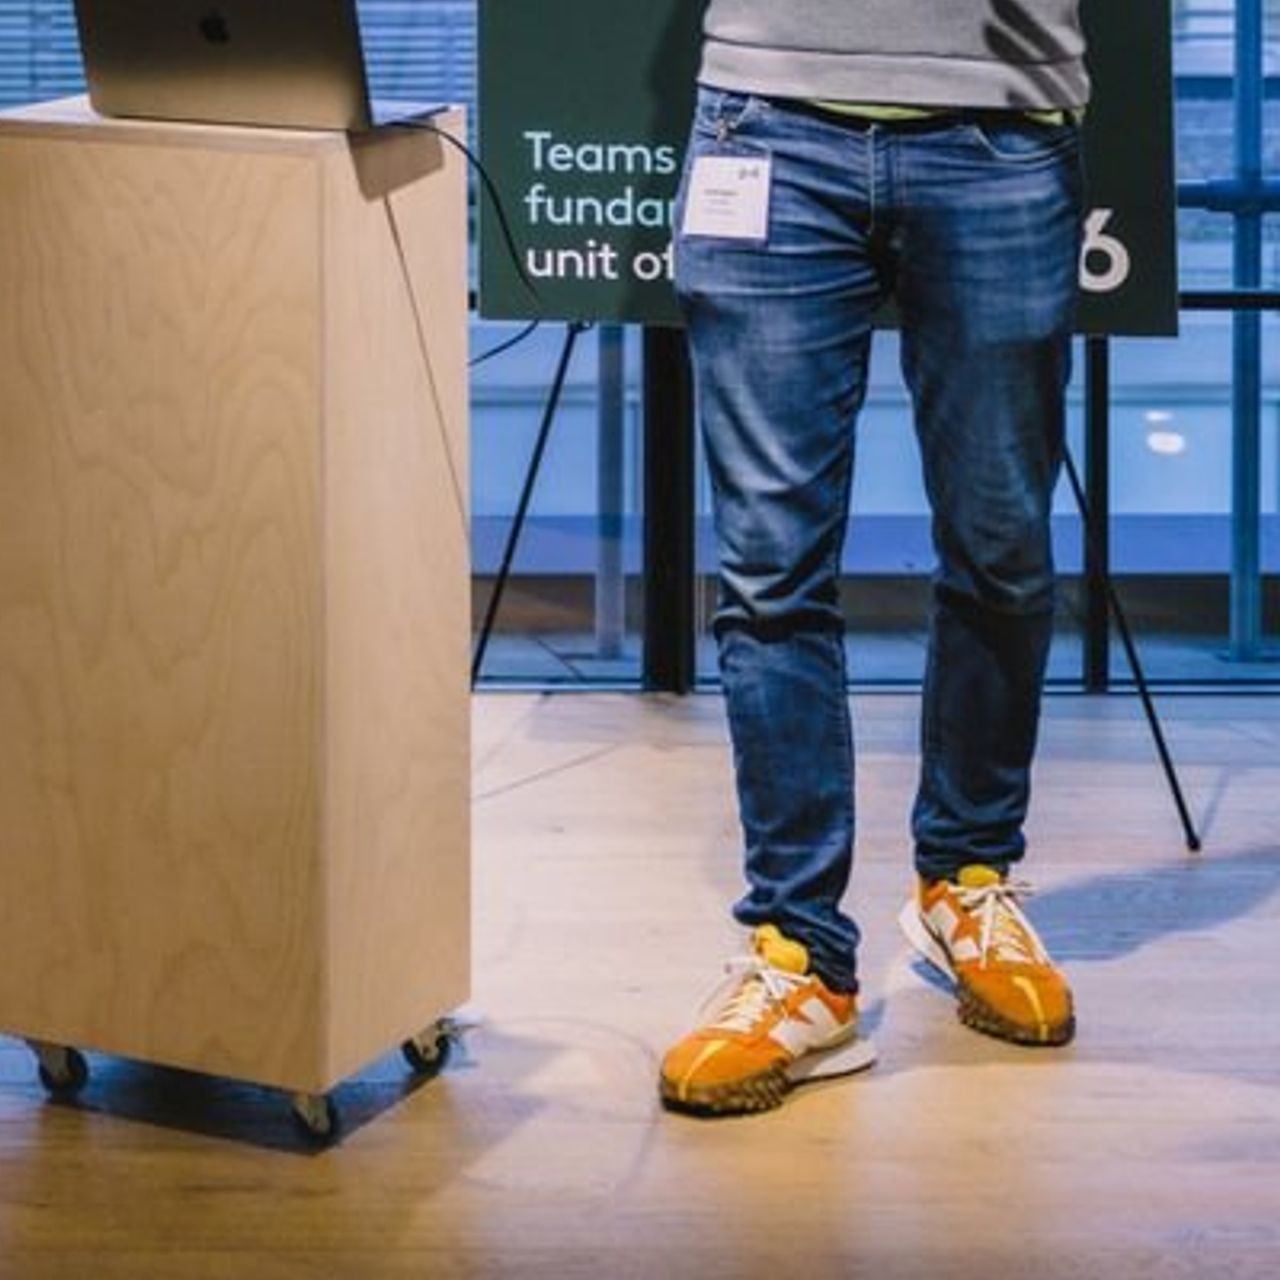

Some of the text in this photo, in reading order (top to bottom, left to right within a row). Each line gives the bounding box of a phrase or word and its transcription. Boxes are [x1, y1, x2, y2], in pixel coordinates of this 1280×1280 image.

[523, 131, 676, 173] Teams
[523, 183, 676, 226] funda
[526, 239, 619, 280] unit
[1078, 207, 1131, 292] 6
